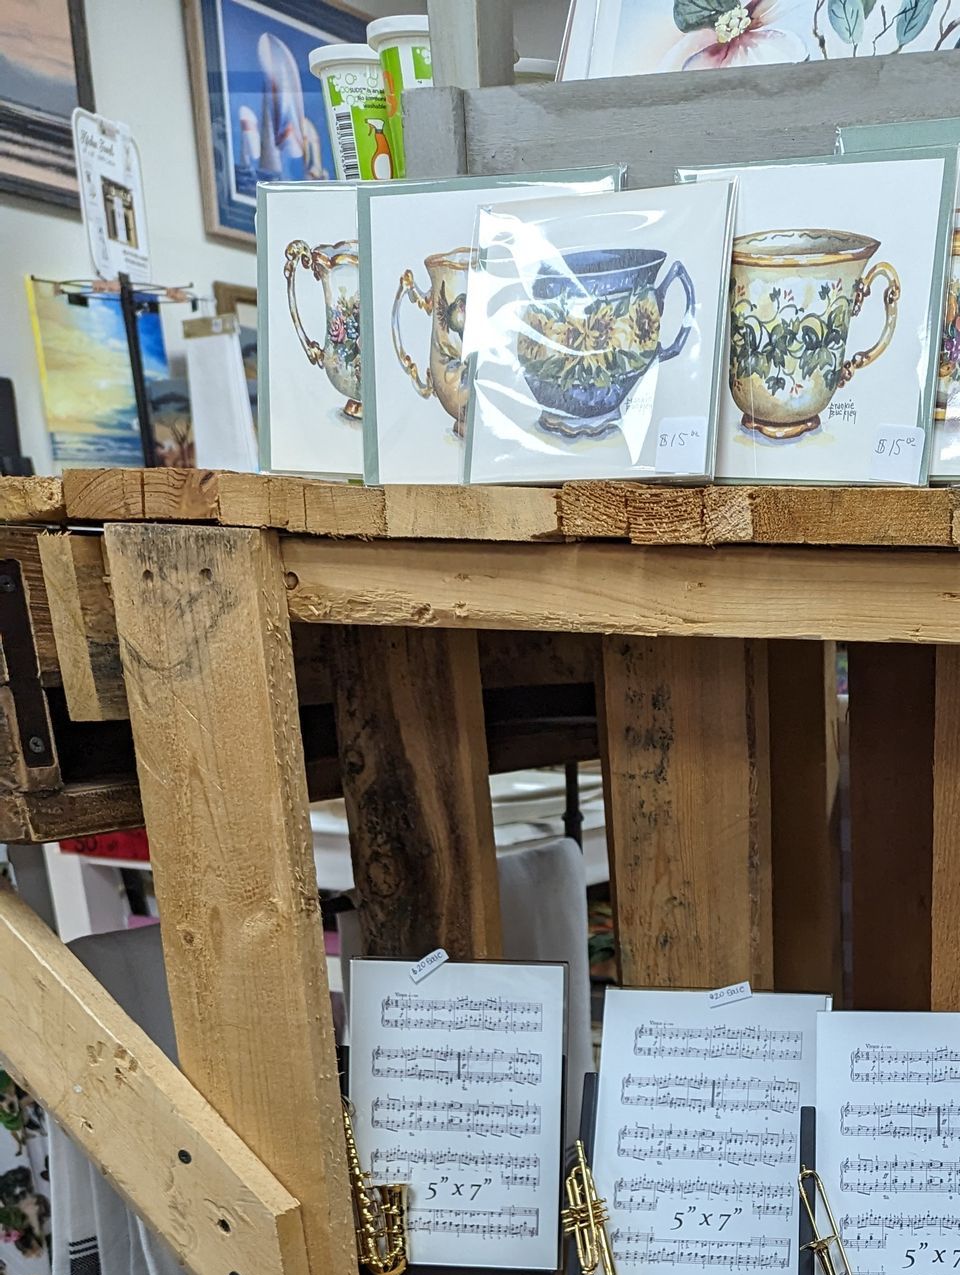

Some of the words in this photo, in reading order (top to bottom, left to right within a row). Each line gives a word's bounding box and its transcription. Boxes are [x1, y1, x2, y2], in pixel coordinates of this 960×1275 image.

[451, 1183, 465, 1197] x
[698, 1213, 713, 1227] x
[931, 1249, 947, 1264] x
